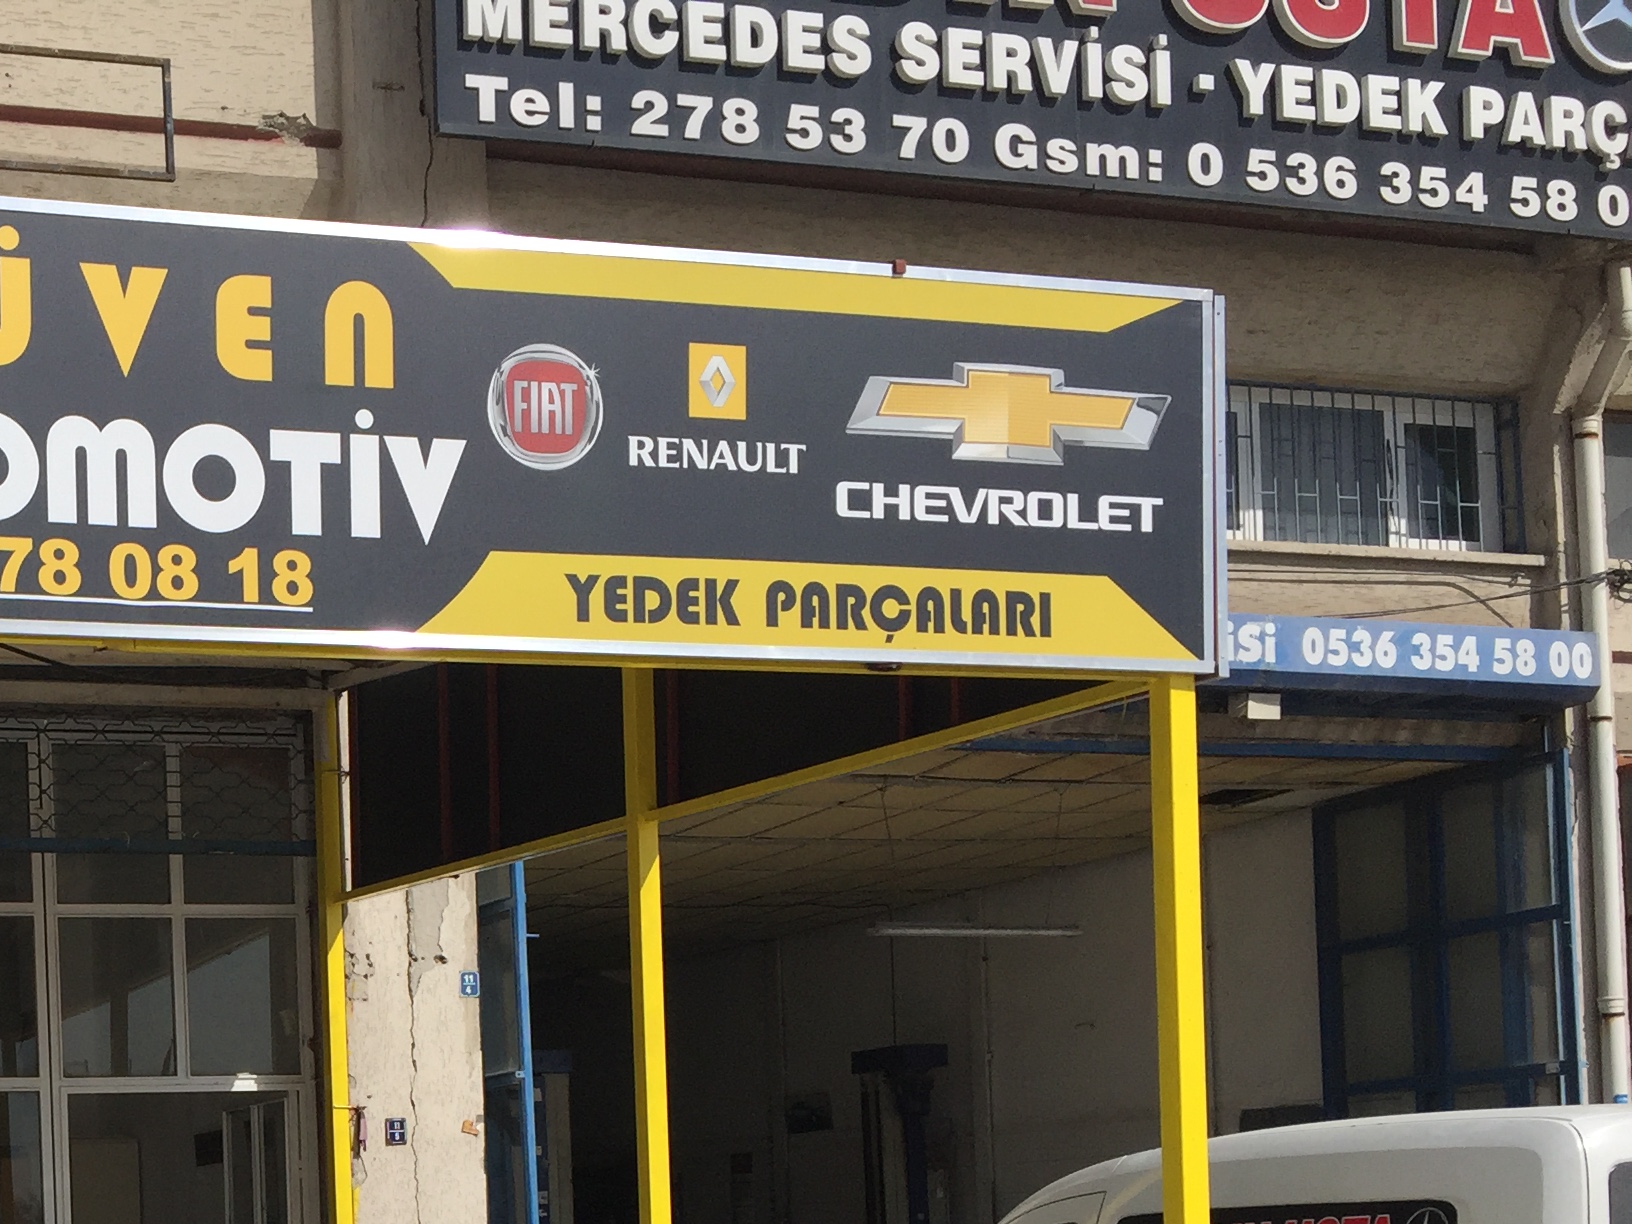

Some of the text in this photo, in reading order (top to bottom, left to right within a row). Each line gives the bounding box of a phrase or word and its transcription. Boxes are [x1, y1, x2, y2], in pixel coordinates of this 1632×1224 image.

[463, 0, 871, 79] MERCEDES
[894, 21, 1171, 107] SERVİSİ
[1228, 58, 1448, 138] YEDEK
[1463, 84, 1632, 171] PARÇ
[464, 74, 602, 131] Tel:
[629, 89, 760, 145] 278
[785, 103, 867, 154] 53
[891, 114, 970, 164] 70
[993, 122, 1163, 182] Gsm:
[1186, 142, 1224, 187] 0
[1245, 150, 1359, 200] 536
[1379, 161, 1489, 213] 354
[1509, 175, 1578, 222] 58
[513, 378, 579, 437] FIAT
[627, 435, 807, 475] RENAULT
[835, 480, 1164, 533] CHEVROLET
[108, 542, 199, 602] 08
[226, 549, 315, 607] 18
[564, 574, 1052, 645] YEDEK PARÇALARI
[1301, 626, 1398, 669] 0536
[1410, 632, 1480, 673] 354
[1493, 637, 1537, 676] 58
[1549, 640, 1593, 679] 00
